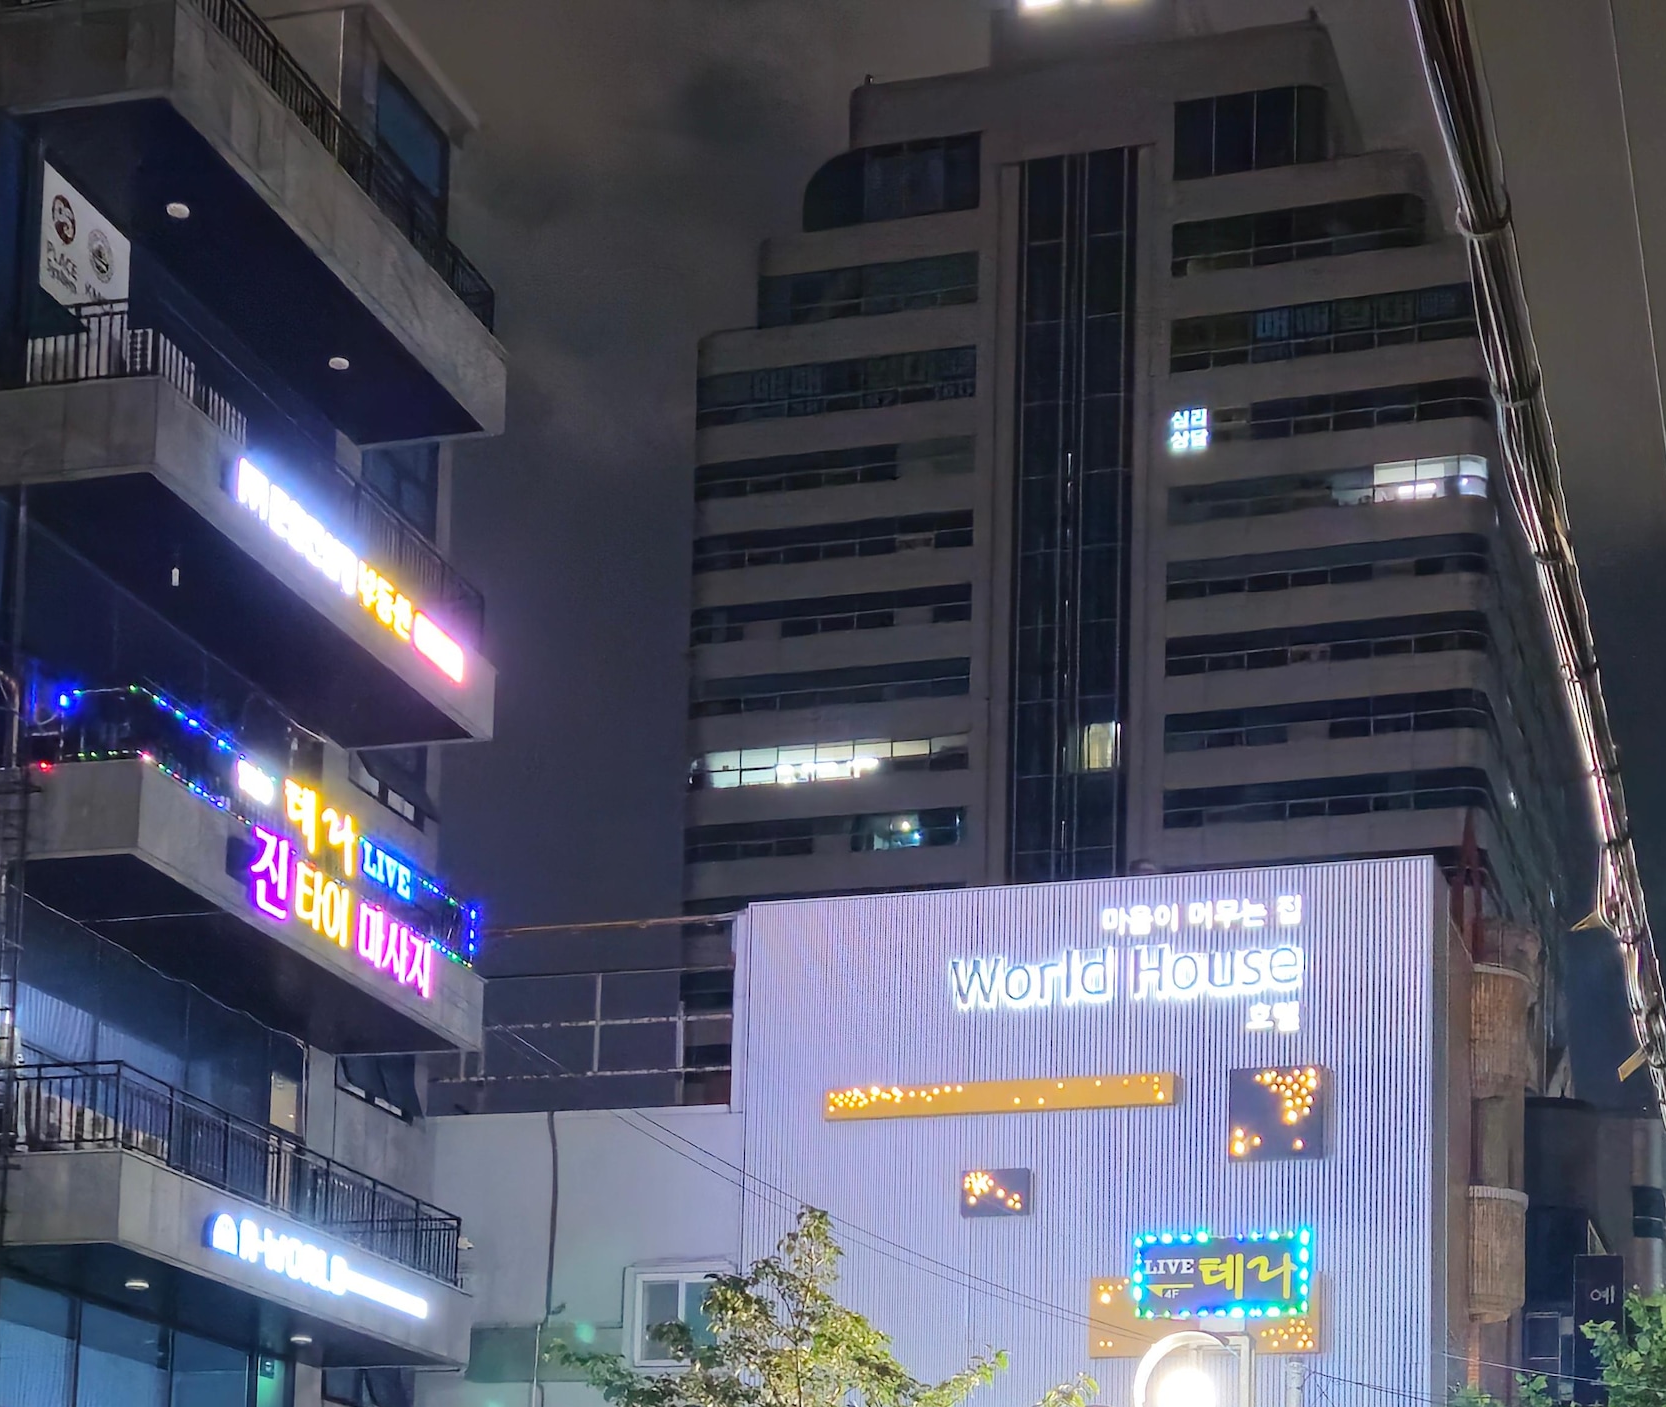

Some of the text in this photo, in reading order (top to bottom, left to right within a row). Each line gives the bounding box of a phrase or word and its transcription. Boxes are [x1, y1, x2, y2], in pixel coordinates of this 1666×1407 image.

[1170, 429, 1209, 450] 상담
[1171, 408, 1208, 429] 심리
[362, 839, 413, 899] LIVE
[250, 826, 433, 999] 진 타이 마사지
[1102, 894, 1302, 936] 마음이 머무는 집
[950, 943, 1304, 1009] World House
[1143, 1249, 1298, 1303] LIVE 테라
[1164, 1288, 1180, 1300] 4F
